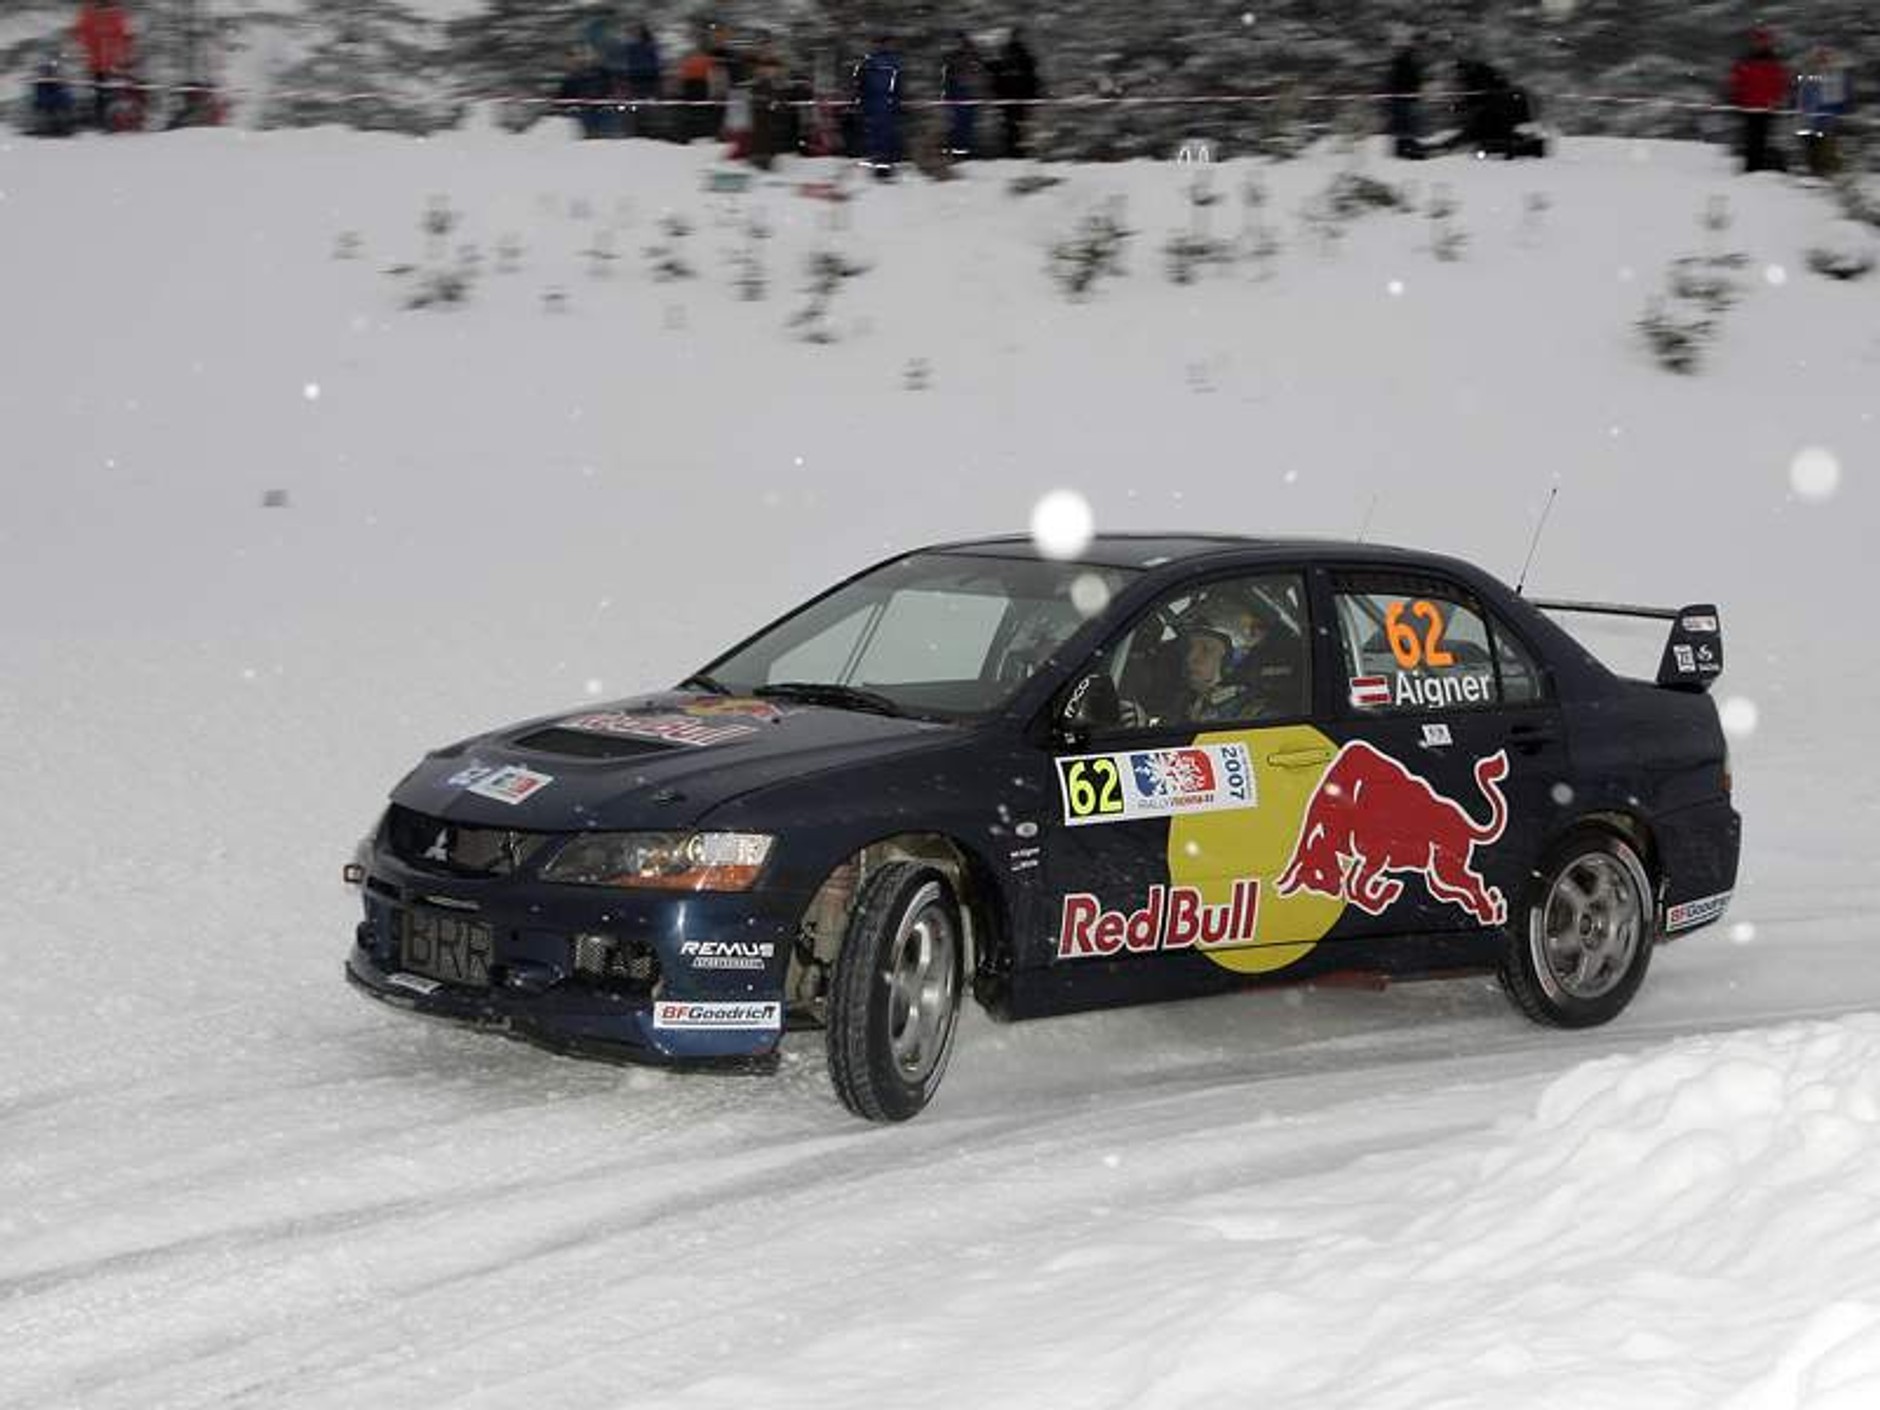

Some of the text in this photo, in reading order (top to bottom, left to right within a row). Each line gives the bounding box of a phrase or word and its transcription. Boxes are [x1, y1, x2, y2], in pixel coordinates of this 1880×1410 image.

[1386, 600, 1454, 669] 62
[1396, 671, 1490, 709] Aigner
[1069, 758, 1123, 815] 62
[1222, 746, 1246, 800] 2007
[1058, 878, 1261, 958] Red Bull
[680, 941, 774, 957] REMUS
